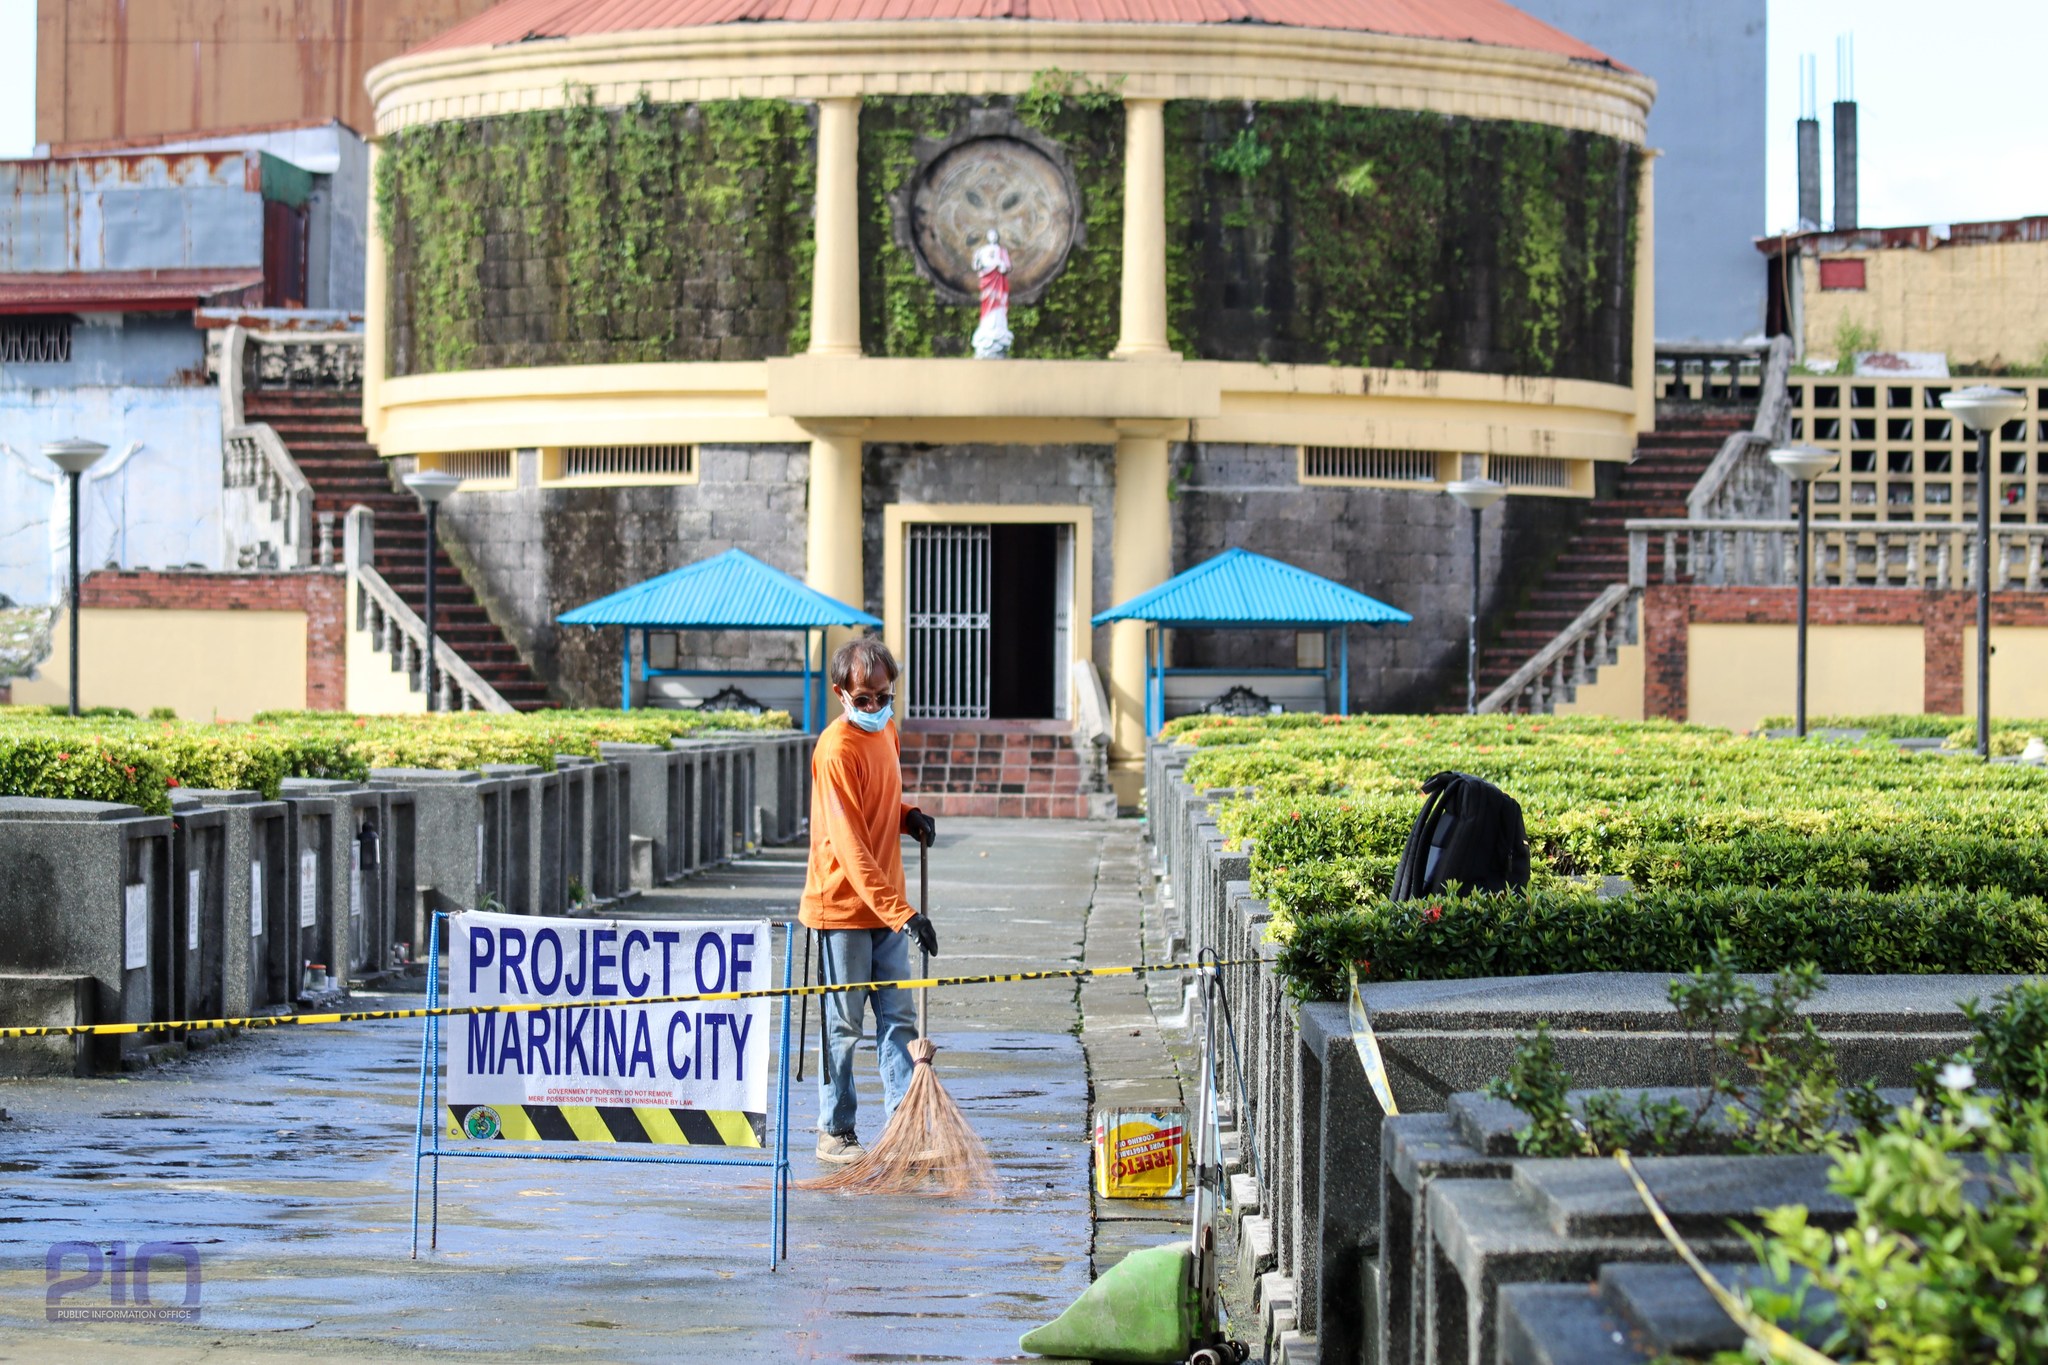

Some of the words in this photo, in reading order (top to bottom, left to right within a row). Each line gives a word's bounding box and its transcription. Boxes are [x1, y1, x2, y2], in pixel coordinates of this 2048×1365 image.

[470, 927, 680, 998] PROJECT
[695, 931, 755, 995] OF
[467, 1008, 656, 1078] MARIKINA
[667, 1010, 753, 1081] CITY
[1127, 1133, 1155, 1144] COOKING
[1150, 1141, 1165, 1150] PURE
